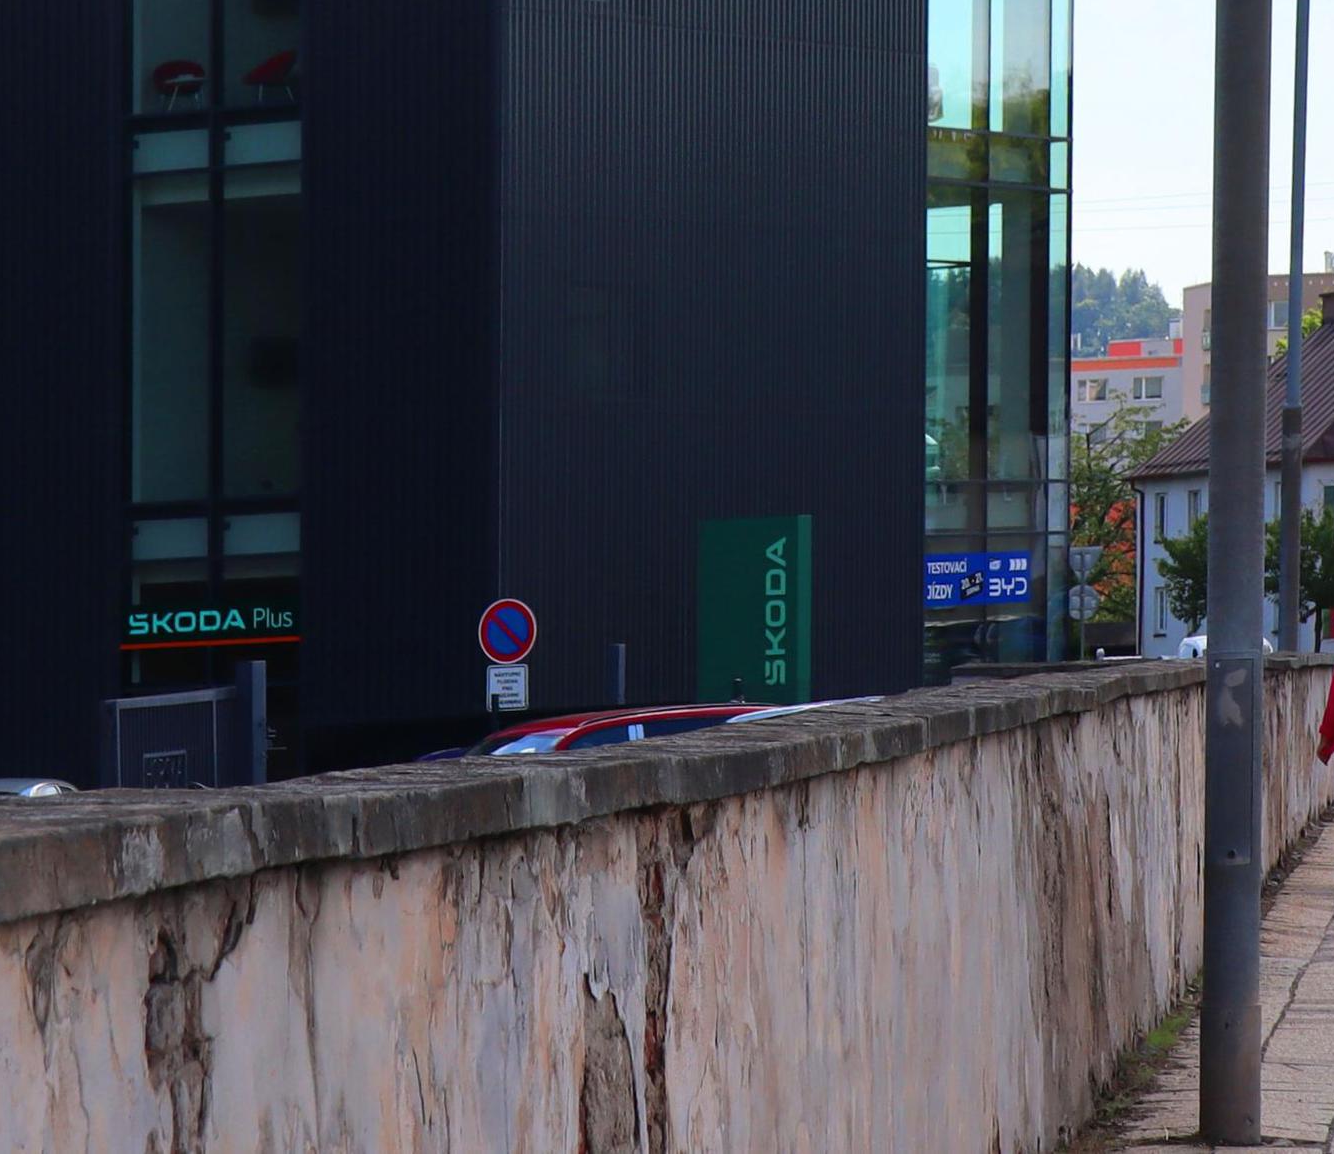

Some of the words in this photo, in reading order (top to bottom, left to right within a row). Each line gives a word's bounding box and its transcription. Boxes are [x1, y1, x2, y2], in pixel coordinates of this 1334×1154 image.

[926, 558, 968, 575] TESTOVACÍ
[926, 581, 954, 600] JÍZDY
[989, 577, 1028, 597] BYD
[252, 607, 294, 629] Plus
